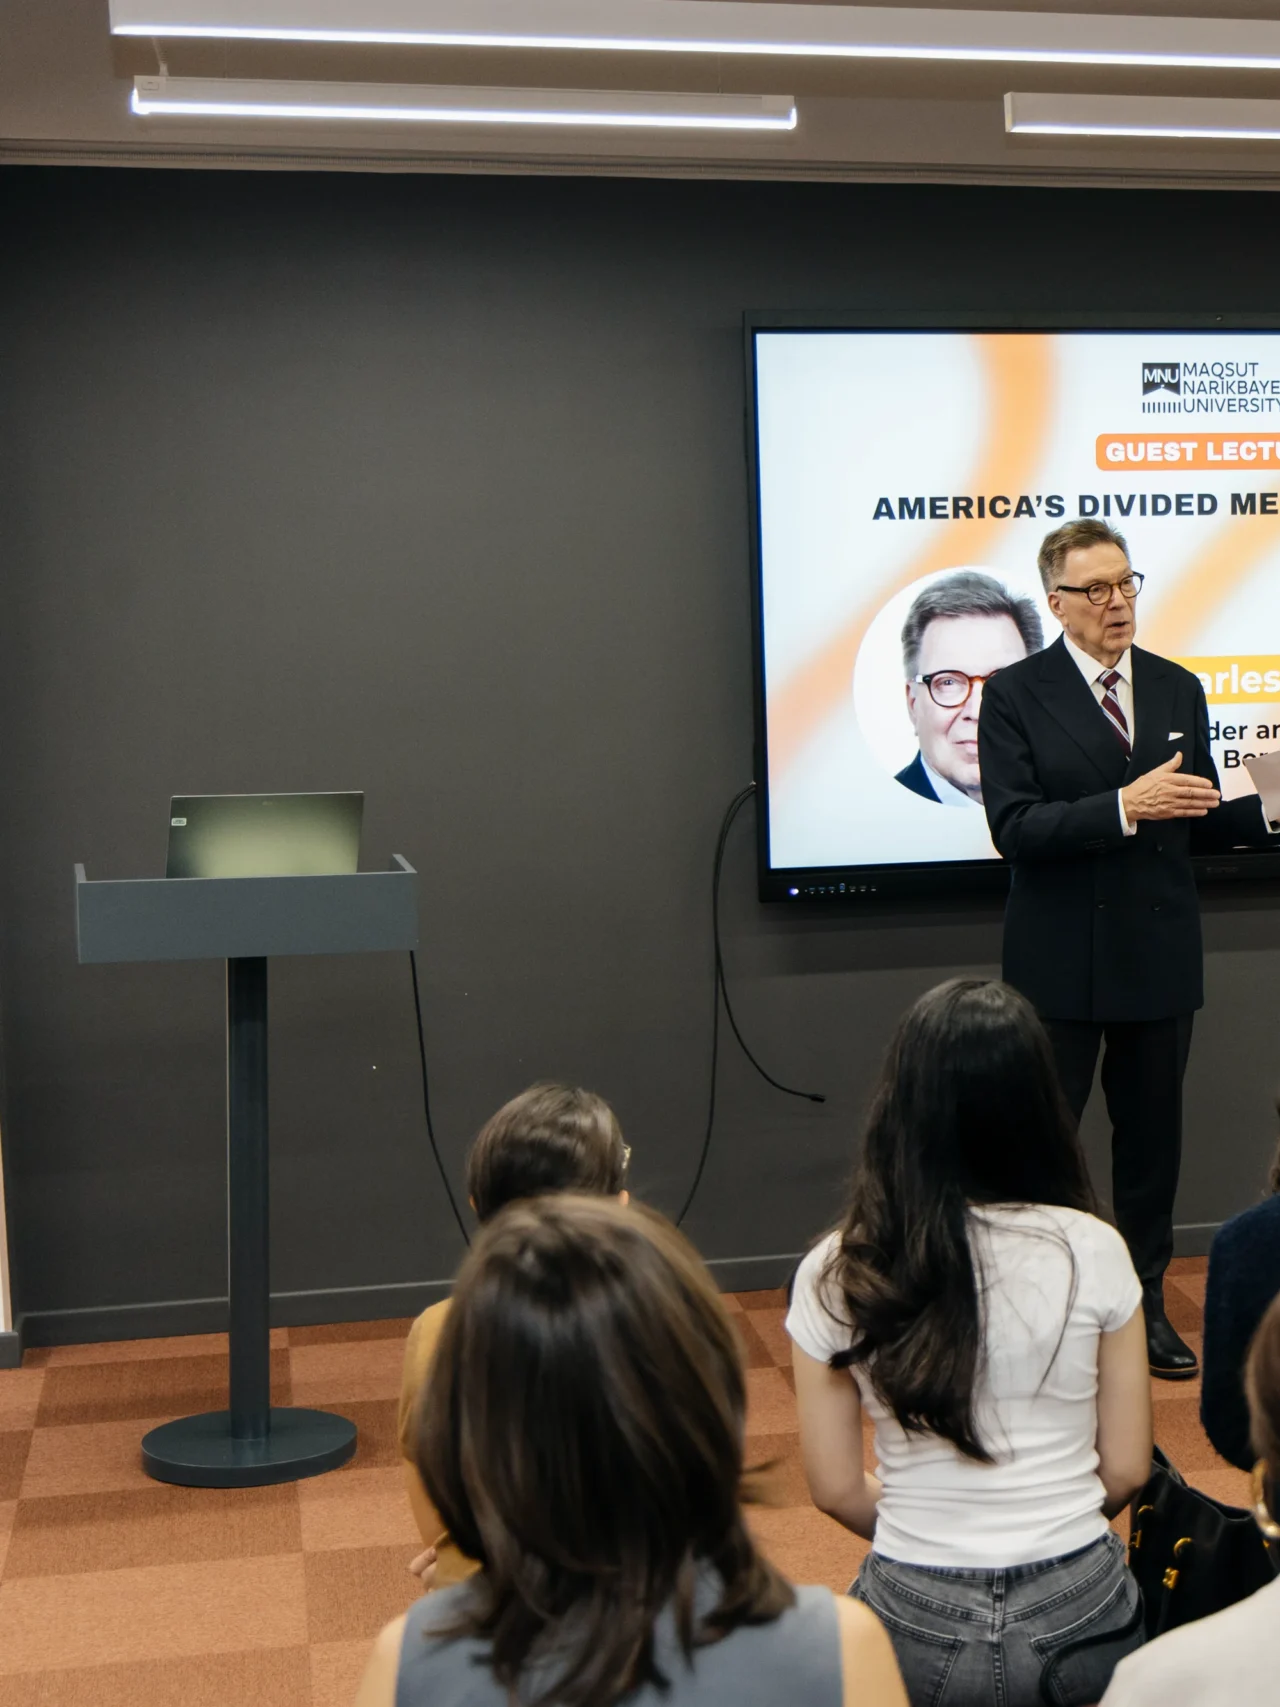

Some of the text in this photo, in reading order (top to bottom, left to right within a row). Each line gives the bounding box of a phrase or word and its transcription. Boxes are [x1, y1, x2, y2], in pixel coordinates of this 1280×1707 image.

[1143, 368, 1179, 384] MNU
[1183, 361, 1259, 380] MAQSUT
[1105, 441, 1198, 462] GUEST
[1078, 493, 1218, 518] DIVIDED
